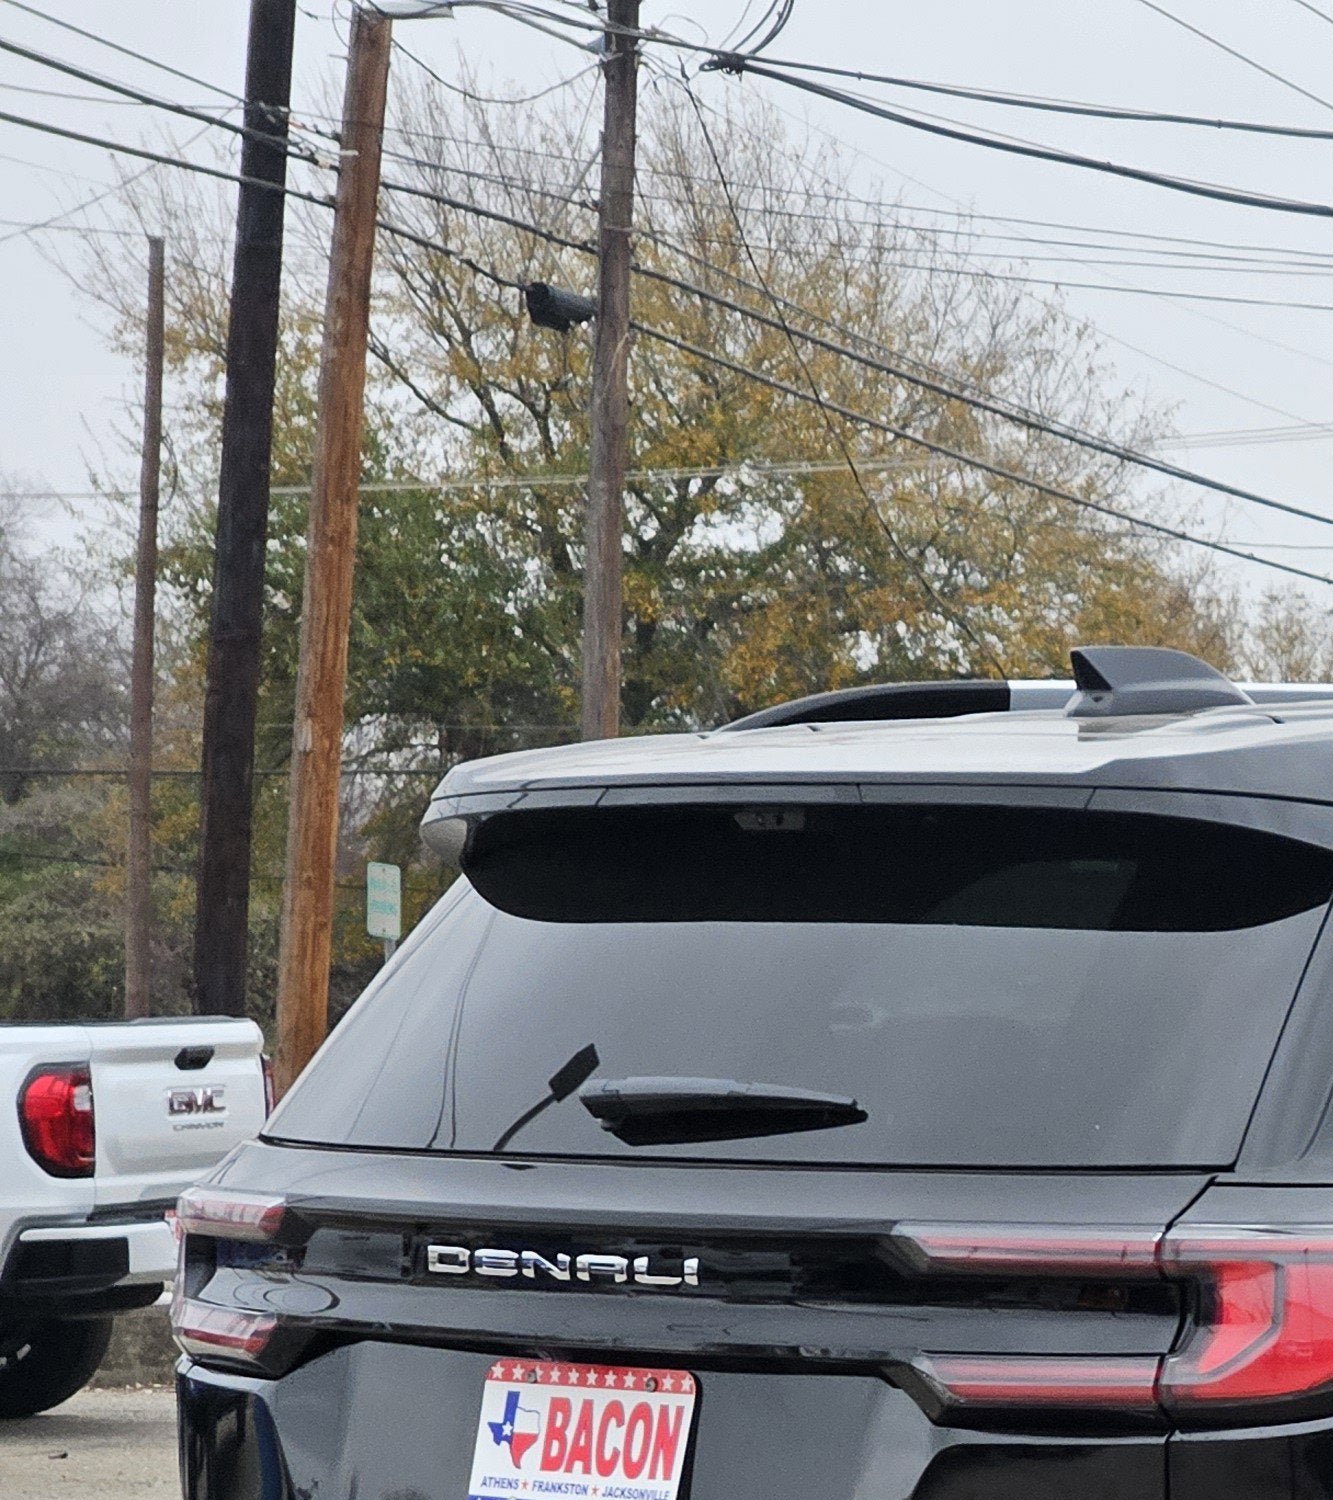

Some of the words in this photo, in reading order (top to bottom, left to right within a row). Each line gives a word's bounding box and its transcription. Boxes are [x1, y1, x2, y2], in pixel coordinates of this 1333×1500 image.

[168, 1087, 226, 1116] GMC
[427, 1244, 699, 1286] DENALI
[540, 1396, 685, 1481] BACON
[480, 1475, 519, 1490] ATHENS
[531, 1480, 589, 1496] FRANKSTON
